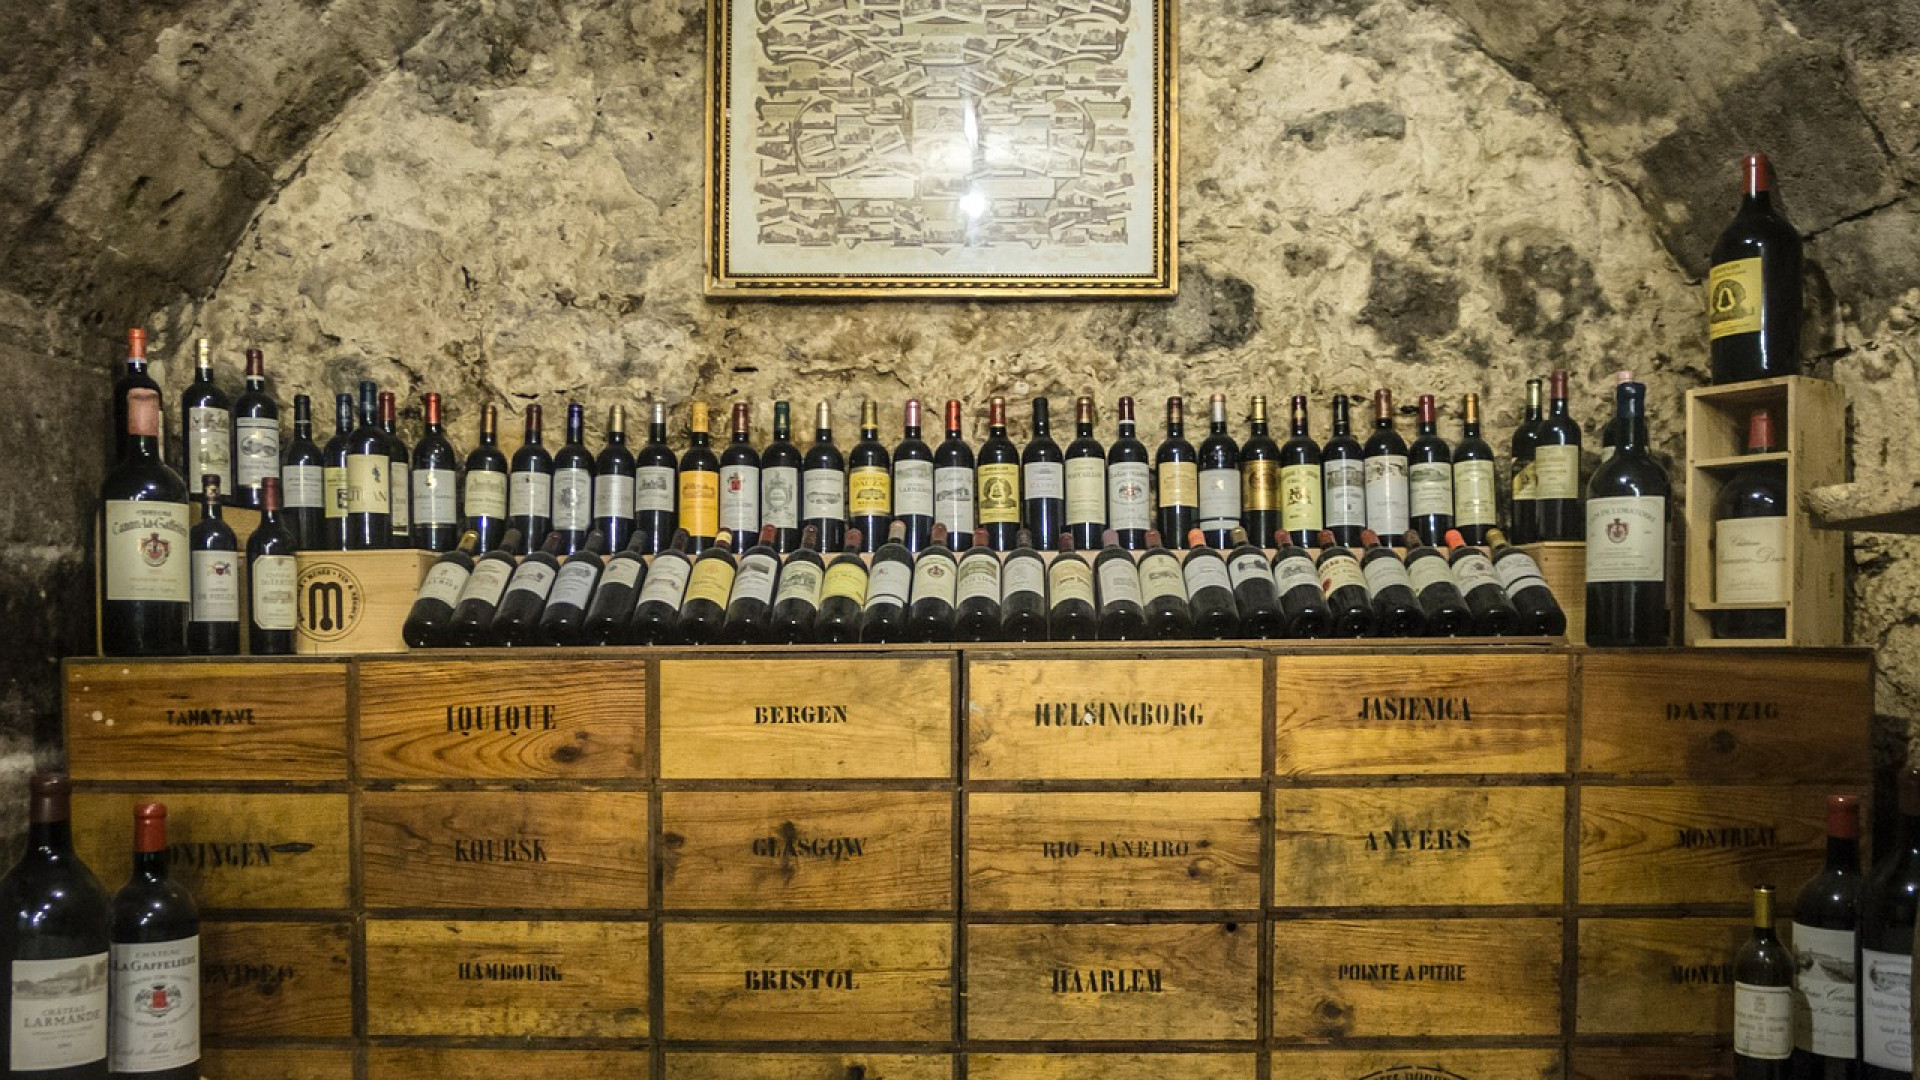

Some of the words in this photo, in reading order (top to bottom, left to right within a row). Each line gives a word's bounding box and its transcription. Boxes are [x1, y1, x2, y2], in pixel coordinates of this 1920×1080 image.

[446, 704, 556, 736] IQUIQUE
[754, 704, 847, 724] BERGEN
[1034, 701, 1204, 727] HELSINGBORG
[1358, 696, 1472, 721] JASIENICA
[455, 839, 547, 861] KOURSK
[752, 837, 868, 861] GLASGOW
[1364, 829, 1471, 851] ANVERS
[459, 962, 562, 981] HAMBOURG
[744, 968, 860, 991] BRISTOL
[1051, 968, 1162, 993] HAARLEM
[1338, 964, 1400, 981] POINTE
[1404, 965, 1415, 980] A
[1418, 963, 1466, 982] PITRE
